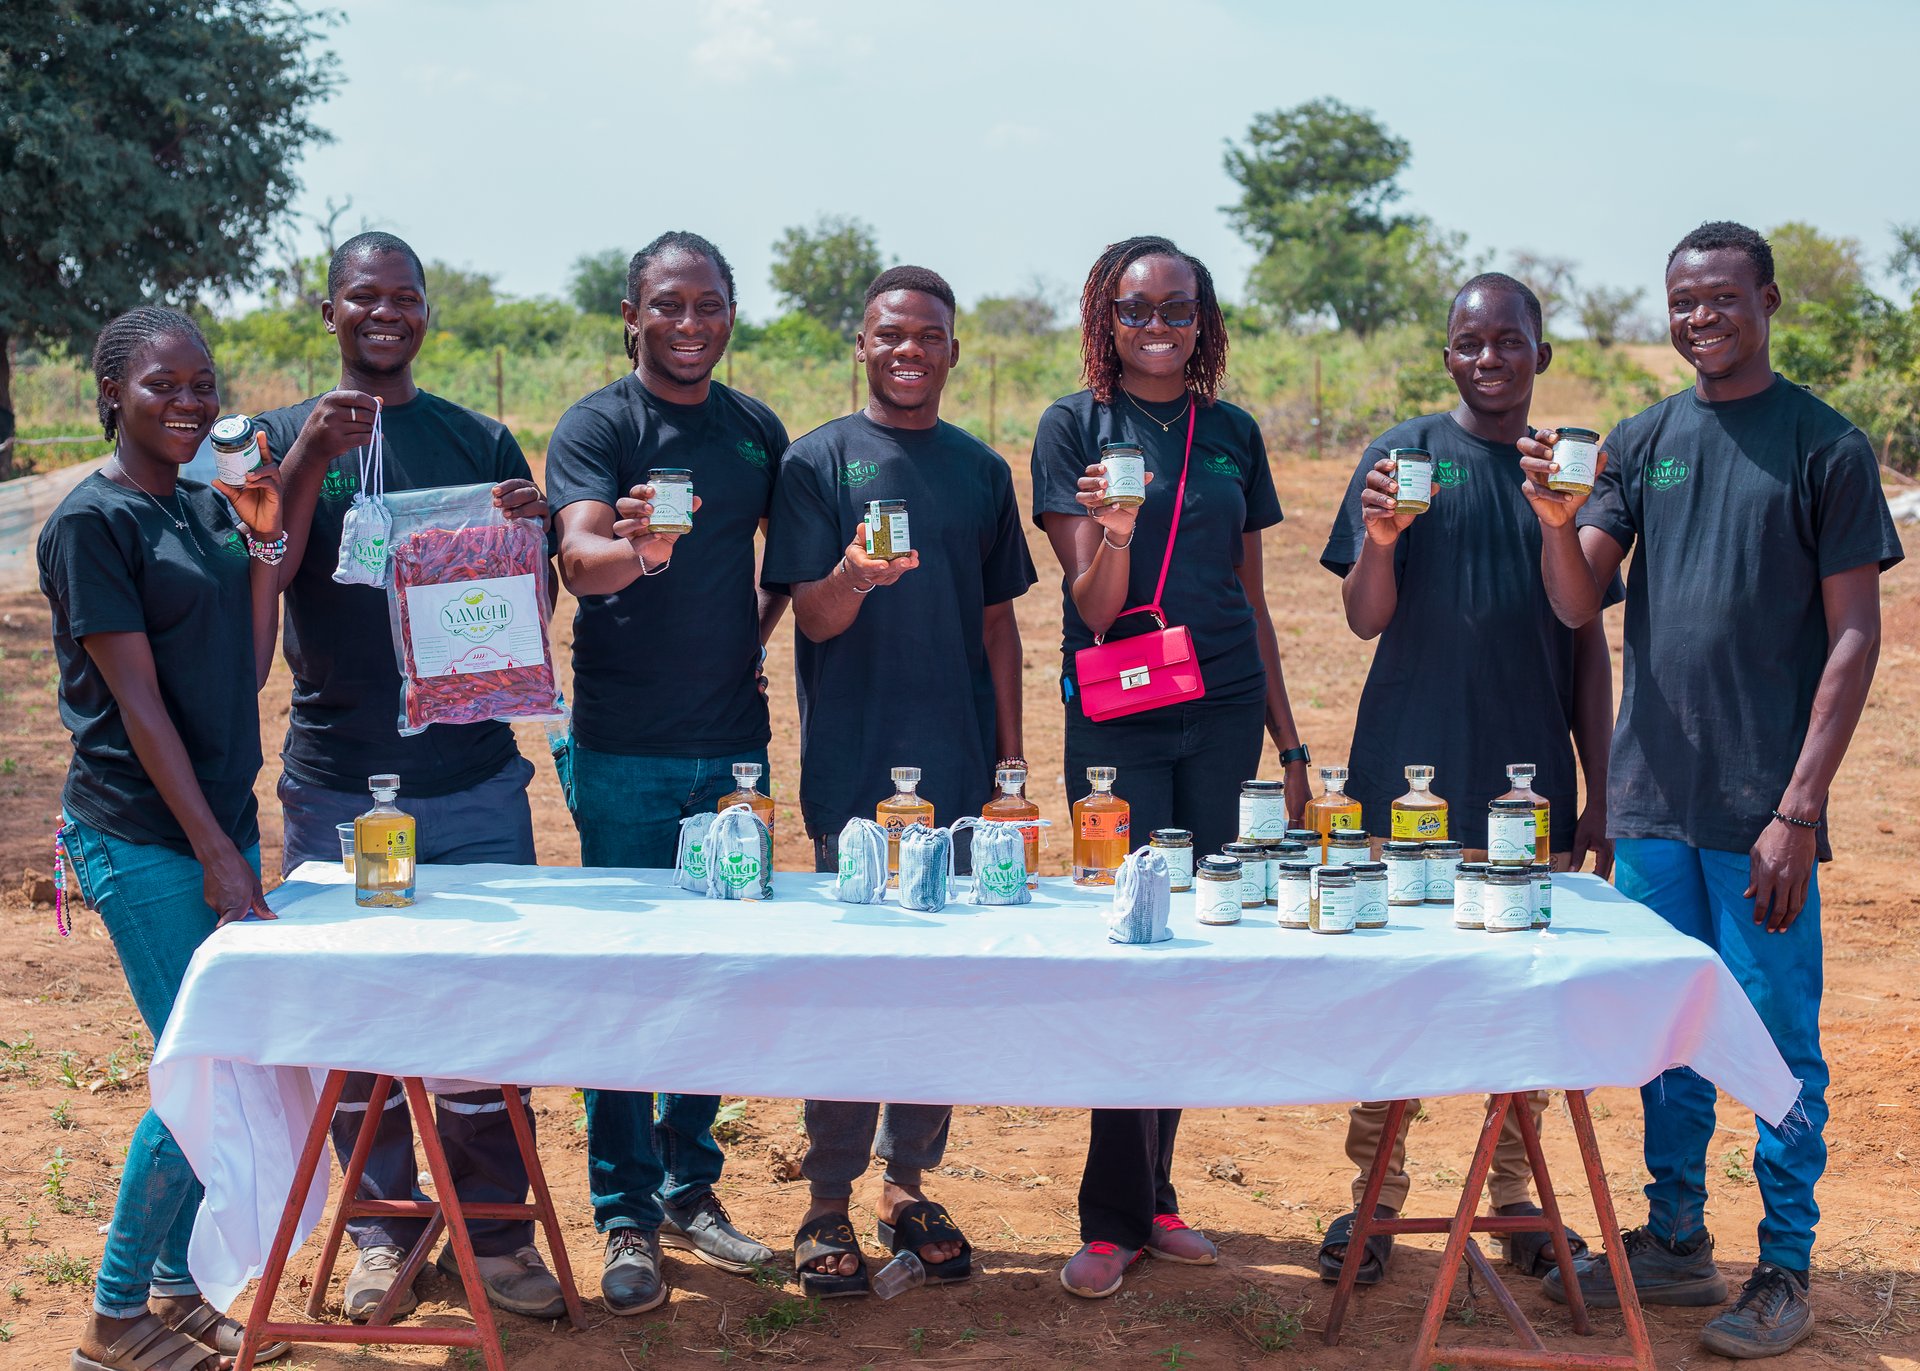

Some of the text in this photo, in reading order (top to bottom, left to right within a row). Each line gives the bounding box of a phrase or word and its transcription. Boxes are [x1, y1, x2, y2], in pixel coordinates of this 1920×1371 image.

[321, 478, 355, 489] AMCHI
[445, 604, 507, 624] YAMCHI
[911, 1212, 959, 1231] Y-3
[807, 1225, 854, 1248] Y-3
